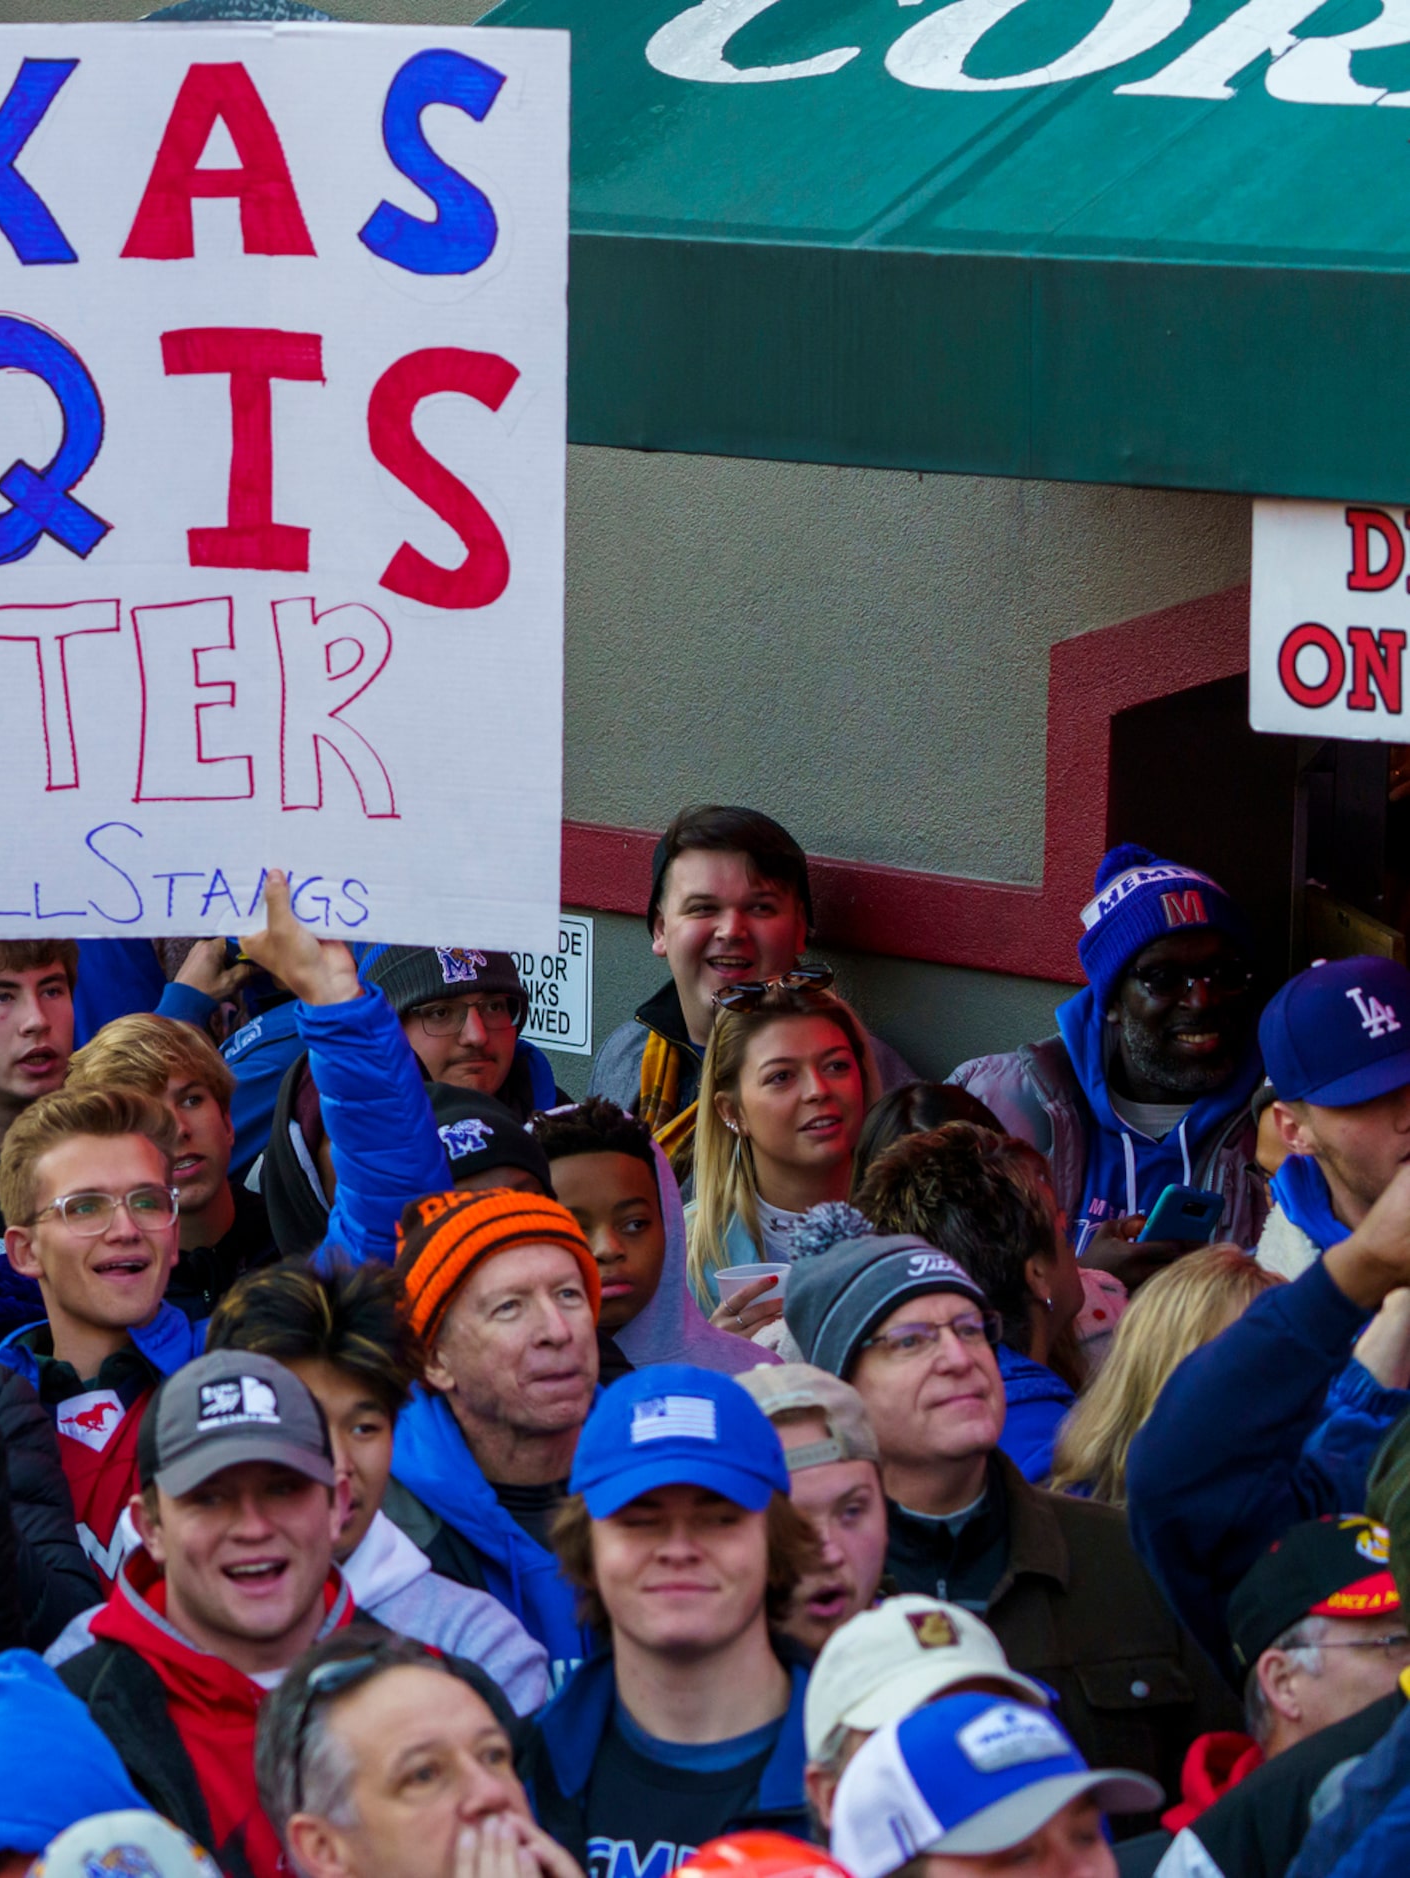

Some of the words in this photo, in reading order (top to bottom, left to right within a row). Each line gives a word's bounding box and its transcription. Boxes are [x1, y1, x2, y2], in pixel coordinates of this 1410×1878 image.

[161, 325, 521, 610] IS
[559, 929, 582, 956] DE
[541, 955, 567, 981] OR
[529, 1007, 570, 1035] WED
[1345, 986, 1401, 1039] LA
